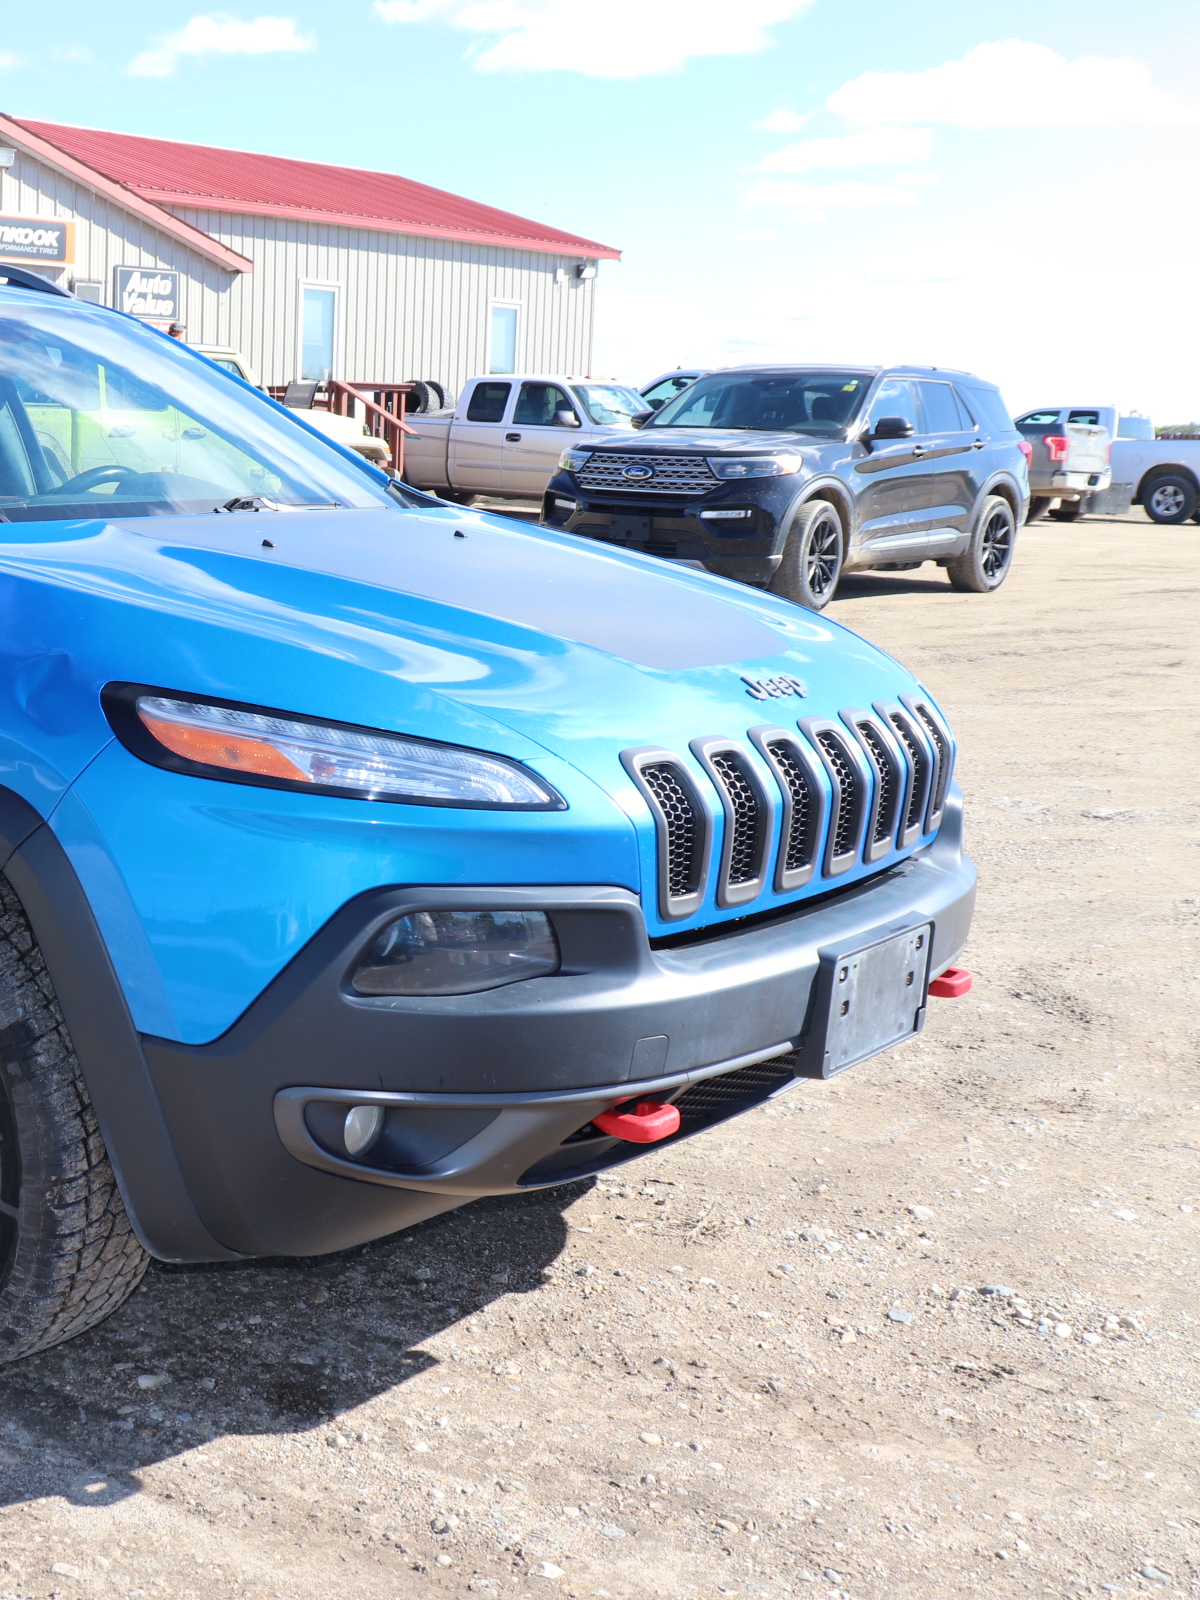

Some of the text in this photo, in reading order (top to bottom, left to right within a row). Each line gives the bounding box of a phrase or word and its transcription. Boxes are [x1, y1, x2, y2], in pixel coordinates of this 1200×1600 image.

[39, 246, 58, 255] TIRES
[125, 271, 172, 295] Auto
[123, 291, 174, 316] Value
[740, 675, 808, 701] Jeep
